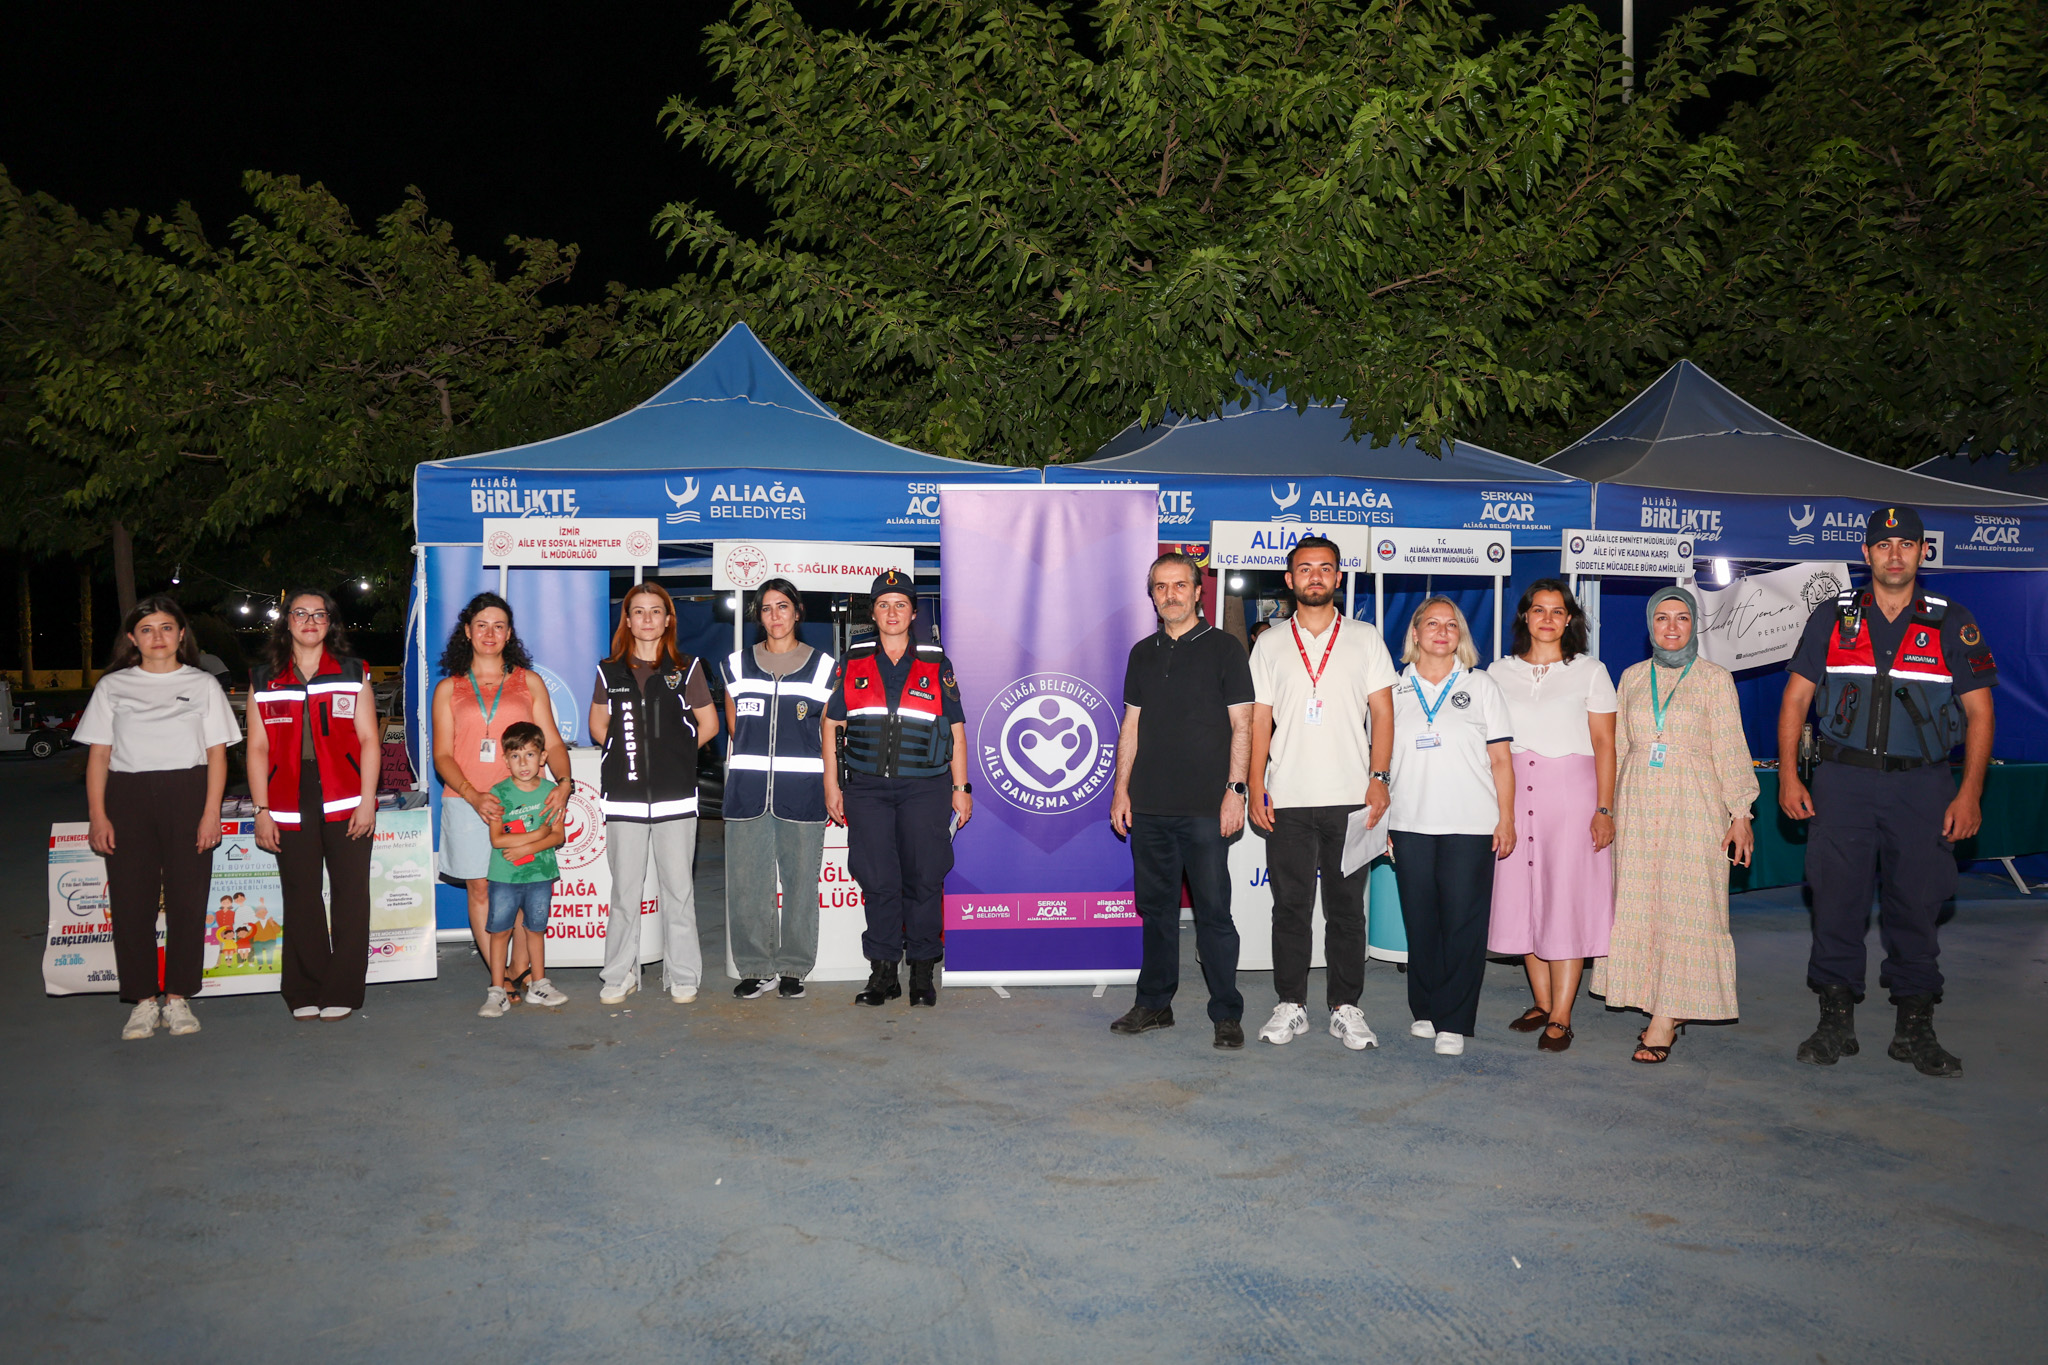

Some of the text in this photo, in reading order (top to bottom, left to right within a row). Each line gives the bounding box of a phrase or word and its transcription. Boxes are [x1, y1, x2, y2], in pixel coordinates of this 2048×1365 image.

[907, 482, 941, 494] SER
[1481, 491, 1534, 502] SERKAN
[906, 496, 940, 518] AC
[1480, 503, 1535, 523] ACAR
[1158, 507, 1196, 525] üzel
[1822, 511, 1871, 529] ALiA
[1974, 515, 2021, 526] SERKAN
[559, 526, 580, 536] İZMİR
[1822, 530, 1867, 543] BELEDi
[1970, 527, 2020, 544] ACAR
[518, 537, 621, 548] AİLE VE SOSYAL HİZMETLER
[1586, 534, 1677, 546] ALİAĞA İLÇE EMNİYET MÜDÜRLÜĞÜ
[541, 549, 597, 559] İL MÜDÜRLÜĞÜ
[1409, 546, 1474, 555] ALİAĞA KAYMAKAMLIĞI
[1593, 547, 1669, 559] AİLE İÇİ VE KADINA KARŞI
[1217, 552, 1288, 566] İLÇE JANDARM
[1404, 554, 1479, 564] İLÇE EMNİYET MÜDÜRLÜĞÜ
[774, 563, 795, 573] T.C.
[797, 562, 839, 574] SAĞLIK
[1576, 561, 1685, 573] ŞİDDETLE MÜCADELE BÜRO AMİRLİĞİ
[1758, 621, 1800, 638] PERFUME
[1904, 655, 1936, 664] JANDARMA
[1000, 679, 1102, 711] ALİAĞA BELEDİYESİ
[984, 743, 1115, 809] AİLE DANIŞMA MERKEZİ
[374, 830, 422, 842] NİM VAR!
[552, 878, 597, 896] LİAĞA
[1036, 907, 1067, 917] ACAR
[62, 922, 95, 935] EVLİLİK
[546, 921, 606, 938] DÜRLÜĞ
[50, 932, 113, 947] GENÇLERİMİZİ
